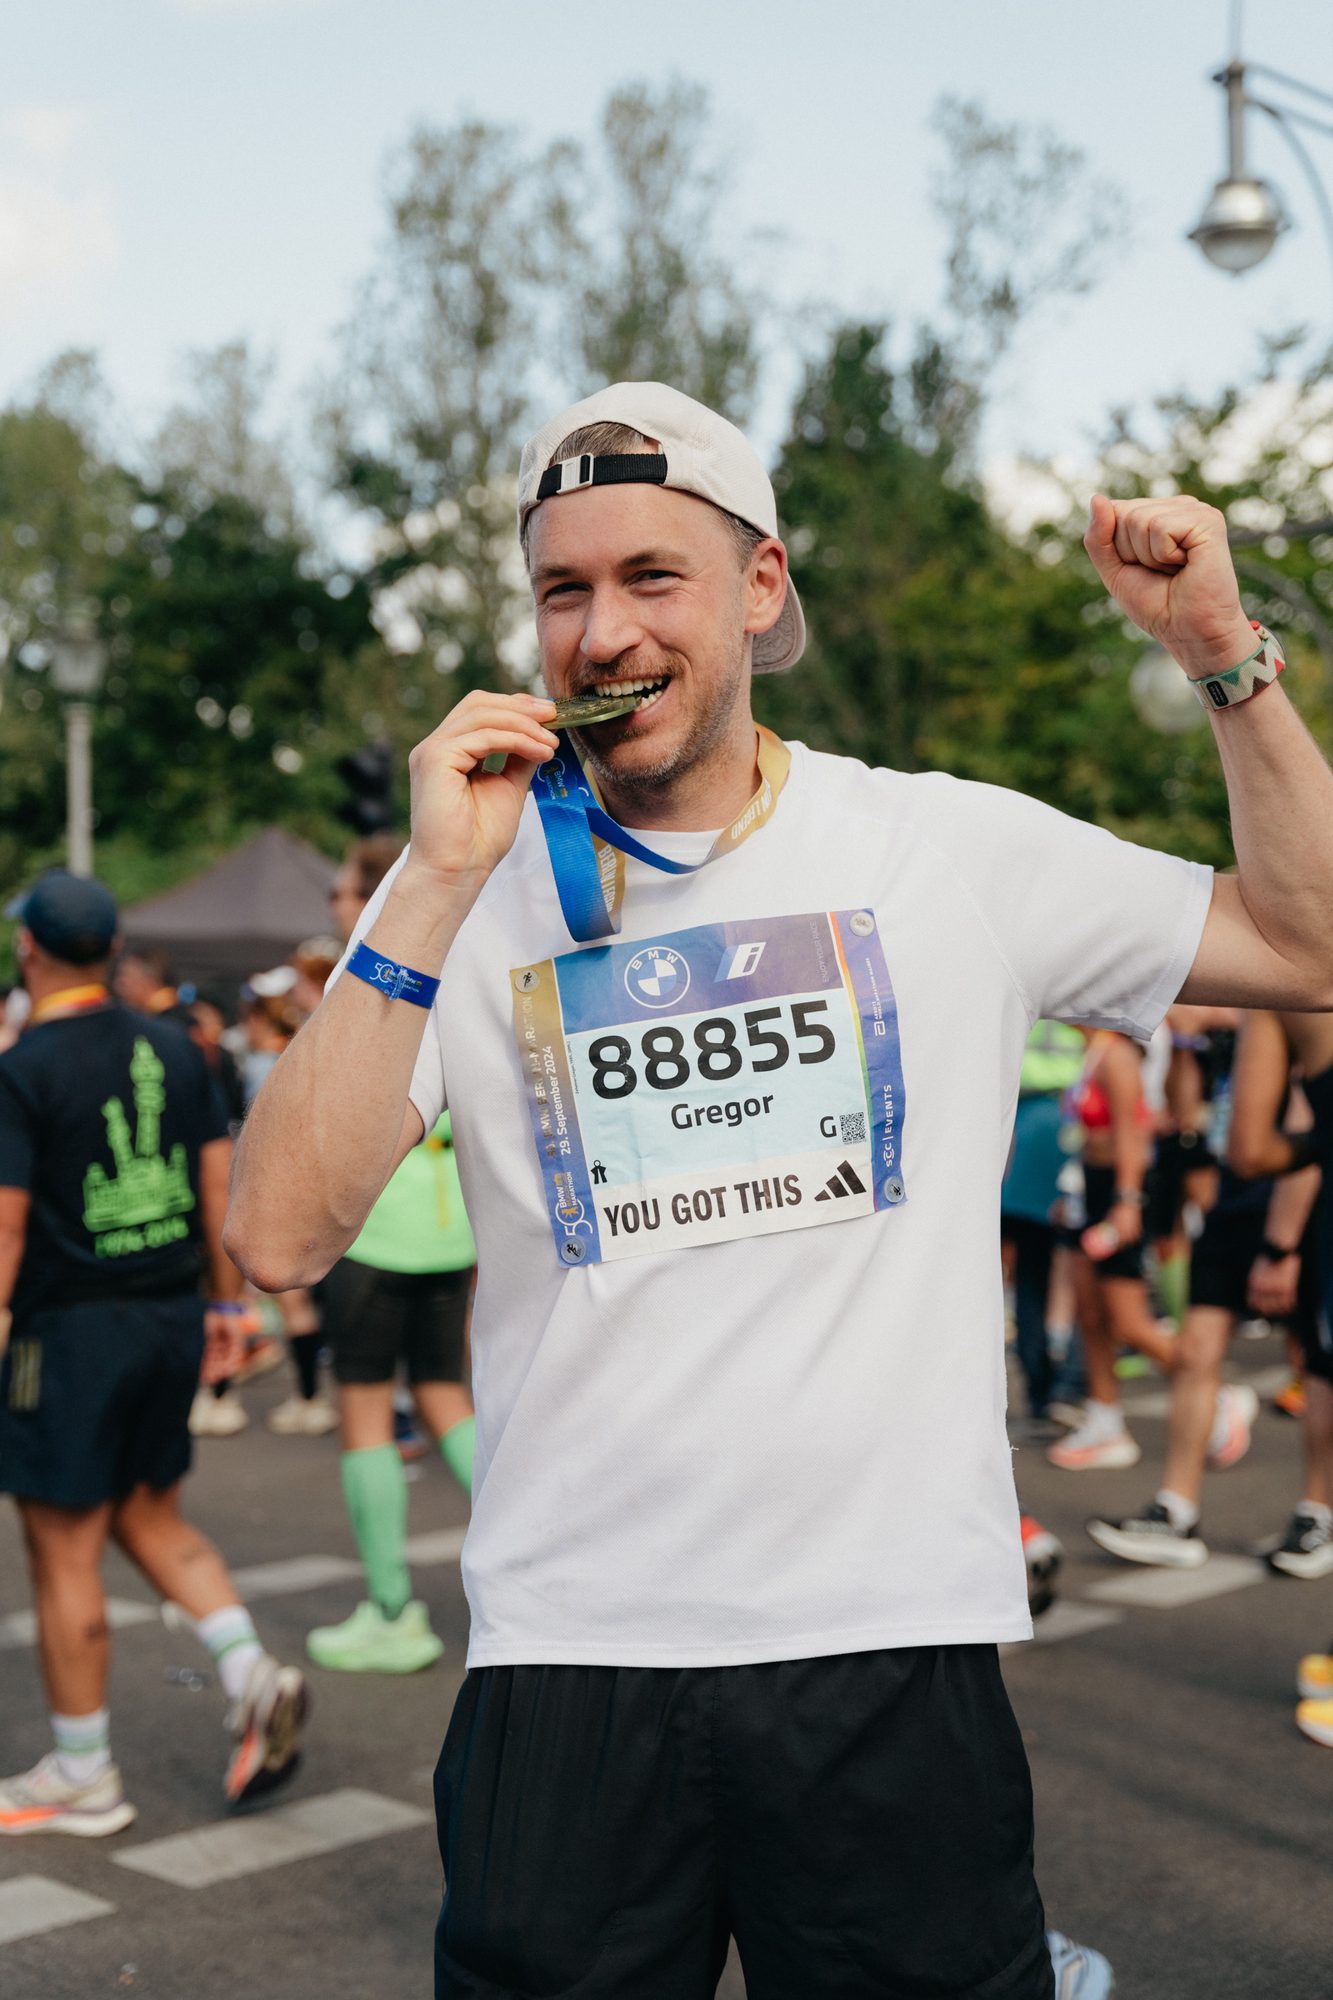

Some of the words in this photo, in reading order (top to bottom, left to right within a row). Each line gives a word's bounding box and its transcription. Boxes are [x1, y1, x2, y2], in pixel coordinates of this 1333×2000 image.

[542, 1045, 557, 1075] 2024
[588, 1000, 836, 1100] 88855
[550, 1076, 567, 1136] September
[671, 1095, 775, 1130] Gregor
[883, 1084, 894, 1135] EVENTS
[820, 1115, 837, 1138] G
[559, 1136, 572, 1156] 29.
[556, 1186, 568, 1208] BMW
[566, 1171, 578, 1206] MARATHON
[603, 1198, 661, 1237] YOU
[671, 1186, 728, 1225] GOT
[734, 1174, 803, 1215] THIS
